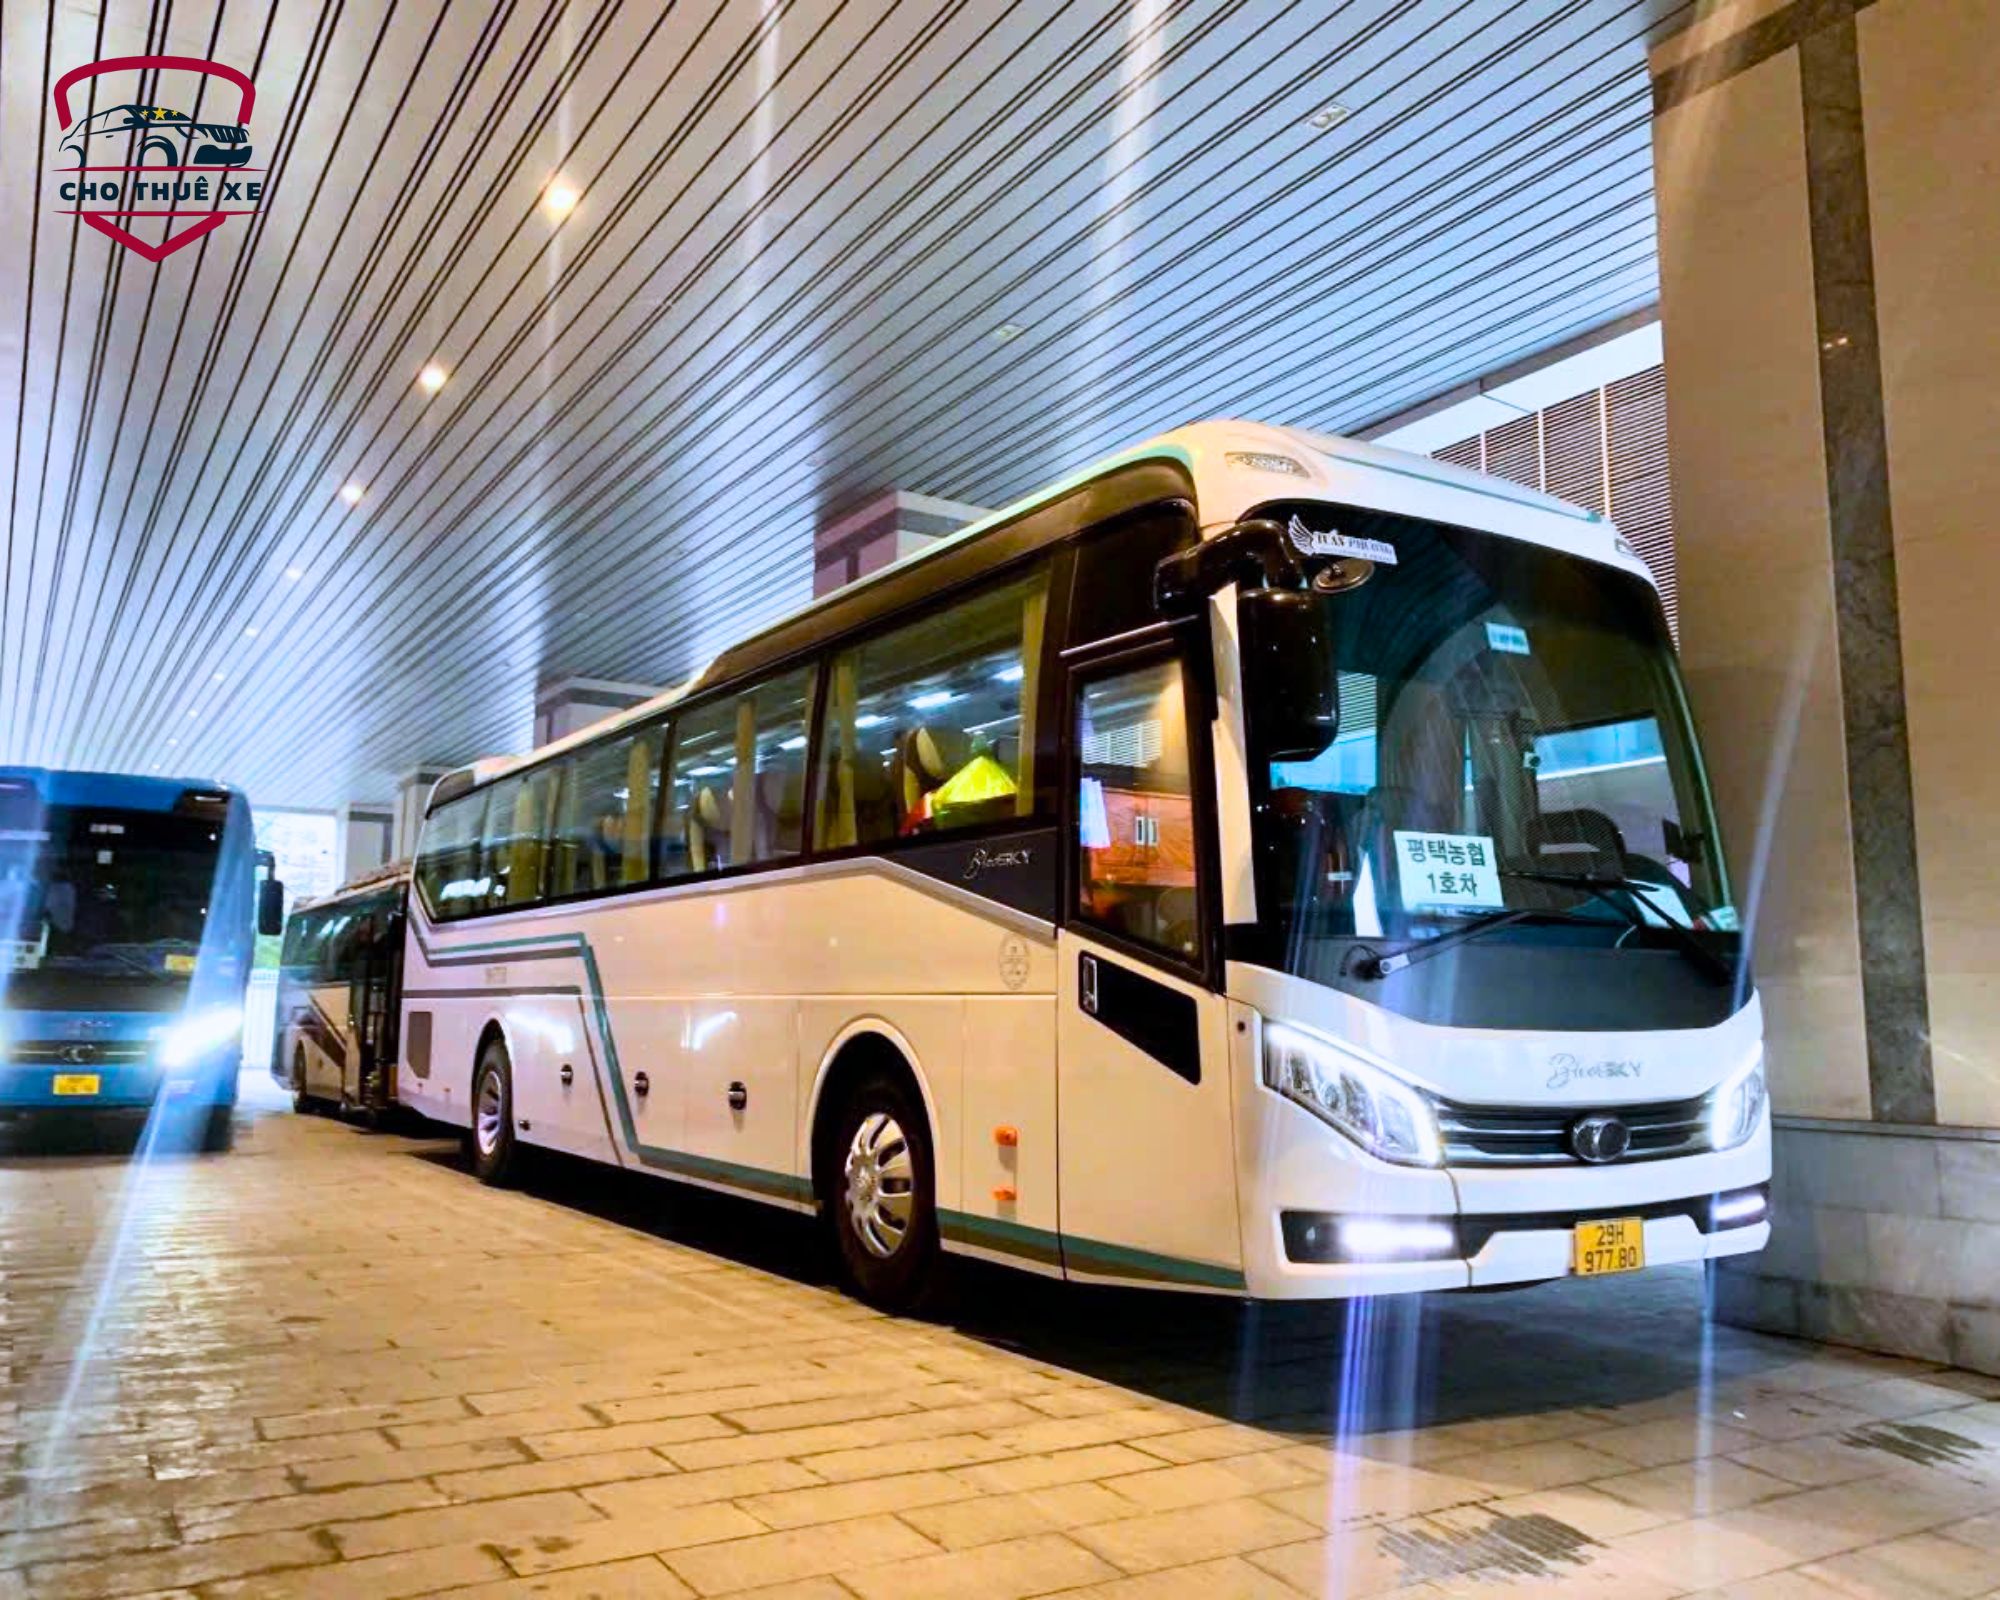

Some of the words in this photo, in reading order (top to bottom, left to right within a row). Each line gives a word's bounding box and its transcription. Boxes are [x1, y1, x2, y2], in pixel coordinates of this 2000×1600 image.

[1406, 839, 1486, 867] 평택농협
[1427, 871, 1477, 897] 1호차
[1596, 1223, 1625, 1246] 29H
